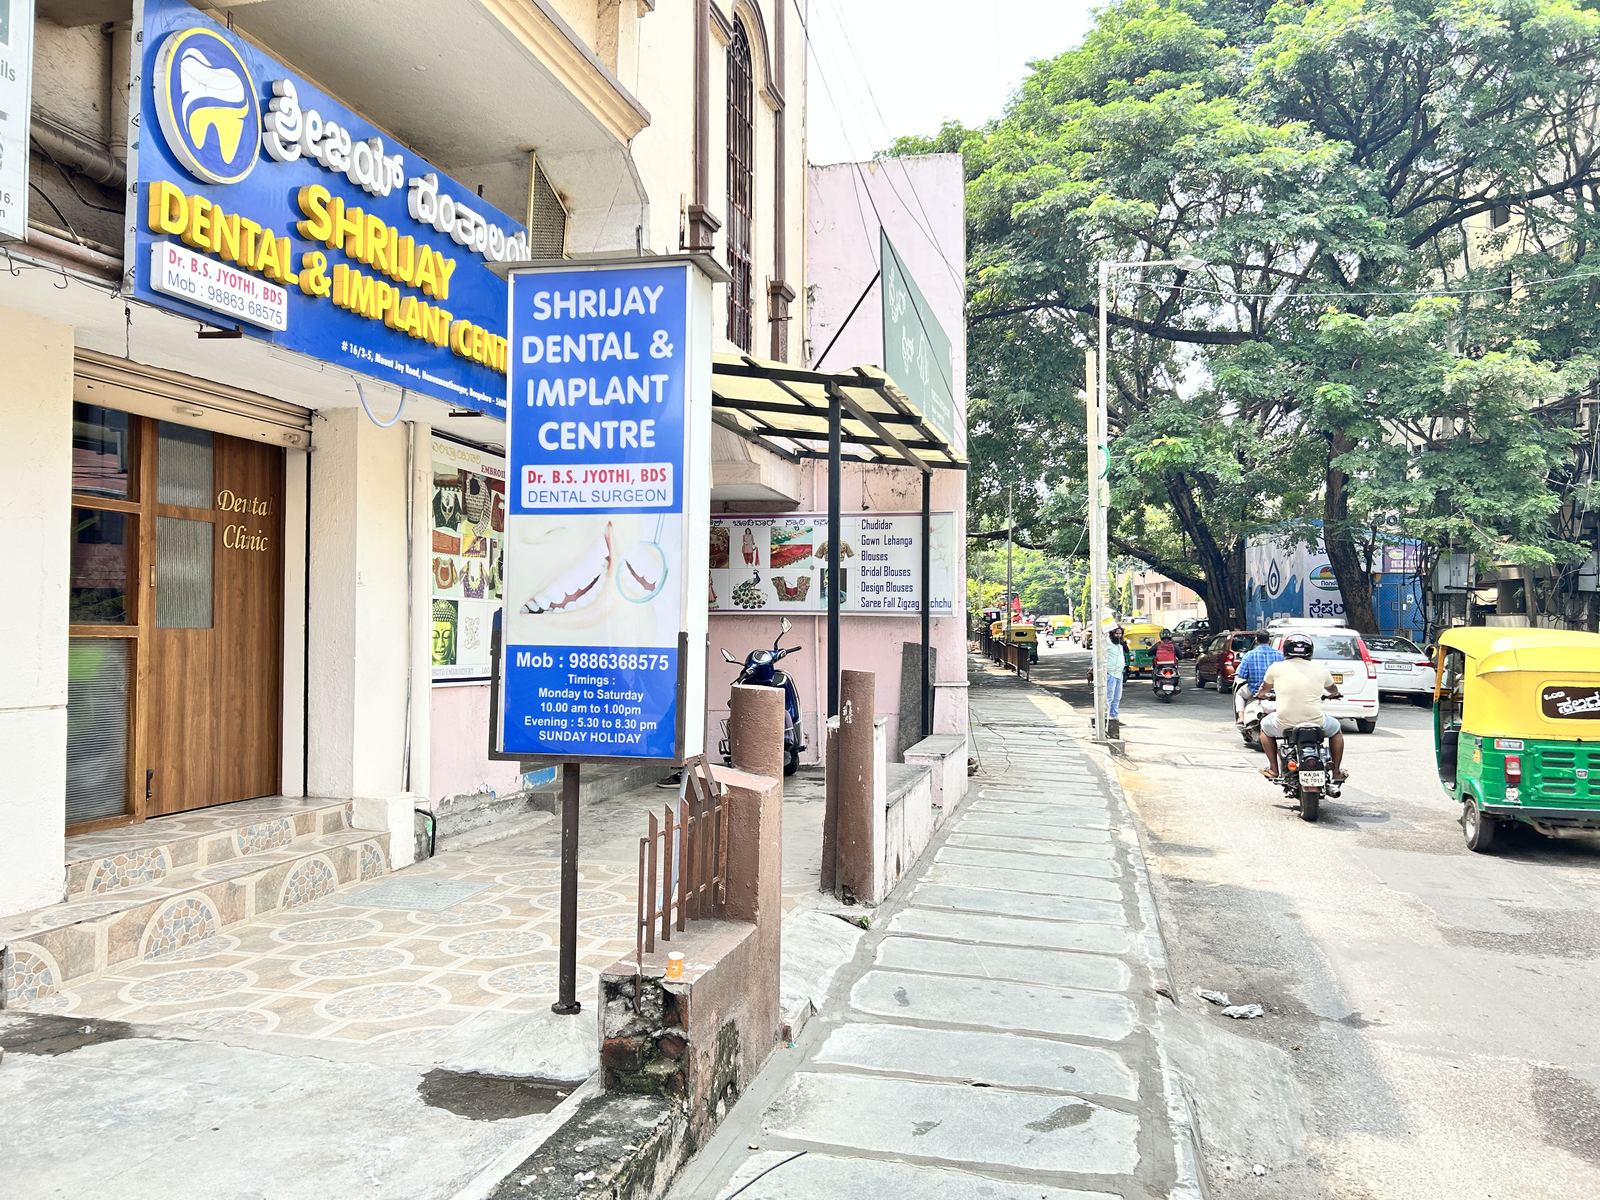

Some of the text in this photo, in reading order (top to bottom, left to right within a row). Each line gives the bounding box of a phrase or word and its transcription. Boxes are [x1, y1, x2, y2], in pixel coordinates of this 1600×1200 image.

[297, 184, 456, 300] SHRIJAY
[149, 180, 299, 285] DENTAL
[299, 251, 331, 297] &
[333, 263, 453, 347] IMPLANT
[168, 249, 283, 306] Dr. B.S. JYOTHI, BDS
[168, 270, 196, 293] Mob
[207, 286, 245, 311] 98863
[248, 301, 283, 325] 68575
[533, 285, 664, 321] SHRIJAY
[522, 329, 674, 364] DENTAL &
[527, 374, 669, 408] IMPLANT
[538, 419, 656, 451] CENTRE
[527, 468, 667, 486] Dr. B.S. JYOTHI, BDS
[528, 489, 666, 503] DENTAL SURGEON
[861, 519, 893, 530] Chudidar
[223, 524, 268, 551] Clinic
[861, 535, 913, 547] Gown Lehanga
[861, 550, 889, 561] Blouses
[861, 566, 911, 577] Bridal Blouses
[861, 582, 913, 594] Design Blouses
[861, 597, 952, 610] Saree Fall Zigzag chchu
[516, 652, 554, 668] Mob
[569, 653, 669, 670] 9886368575
[568, 674, 609, 687] Timings
[538, 688, 644, 703] Monday to Saturday
[540, 702, 641, 717] 10.00 am to 1.00pm
[524, 716, 568, 728] Evening
[577, 717, 599, 728] 5.30
[602, 718, 612, 729] to
[615, 719, 637, 729] 8.30
[640, 723, 657, 731] pm
[538, 731, 641, 743] SUNDAY HOLIDAY
